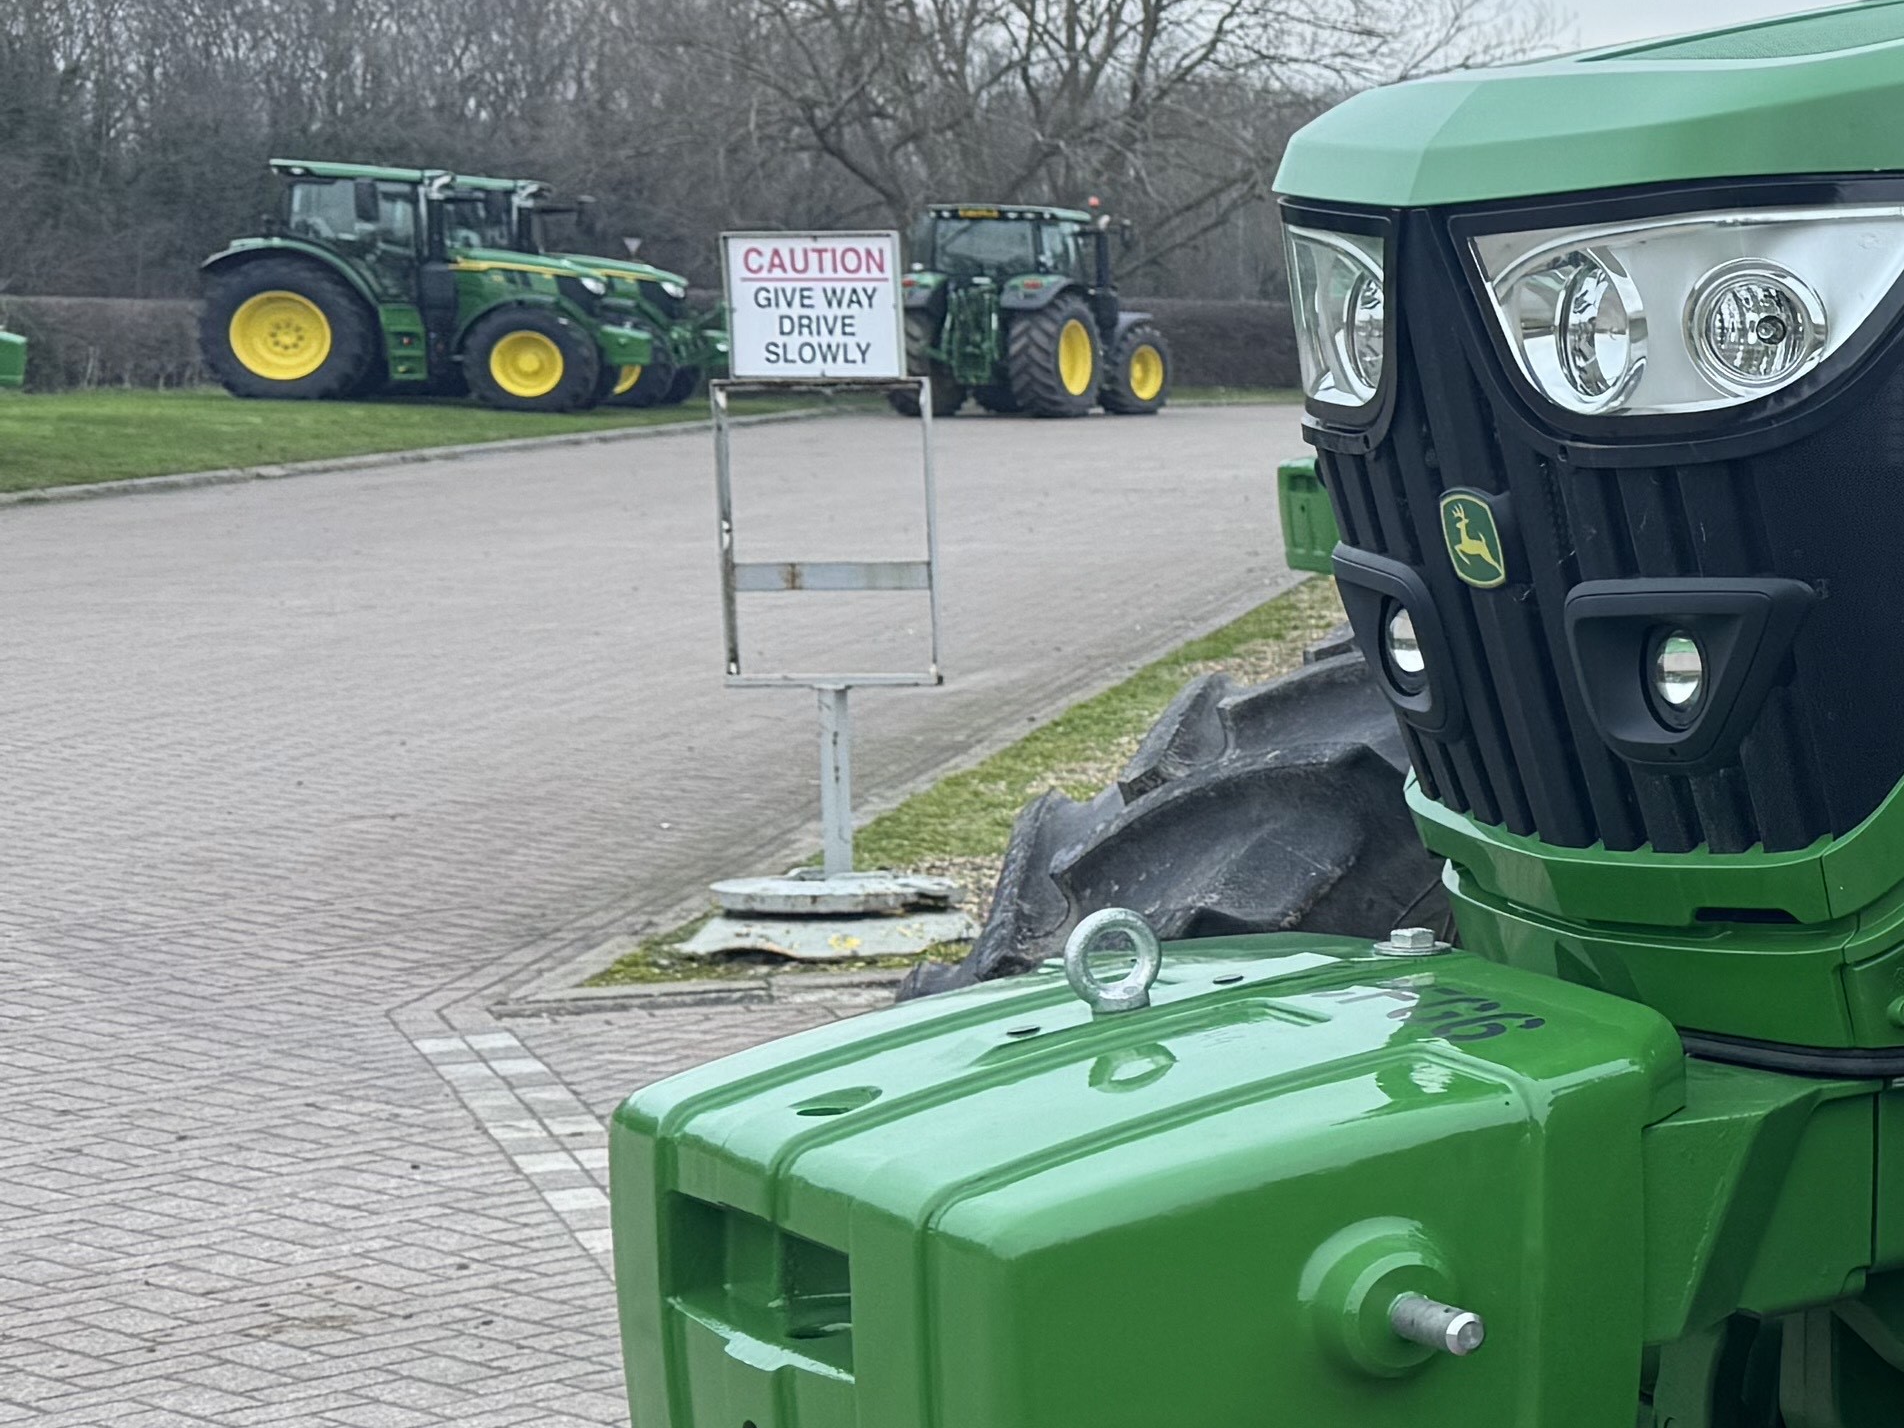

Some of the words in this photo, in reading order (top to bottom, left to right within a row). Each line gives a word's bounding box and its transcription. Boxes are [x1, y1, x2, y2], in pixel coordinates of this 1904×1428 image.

[743, 247, 885, 275] CAUTION
[754, 287, 815, 309] GIVE
[823, 287, 877, 309] WAY
[779, 315, 856, 337] DRIVE
[764, 342, 871, 364] SLOWLY
